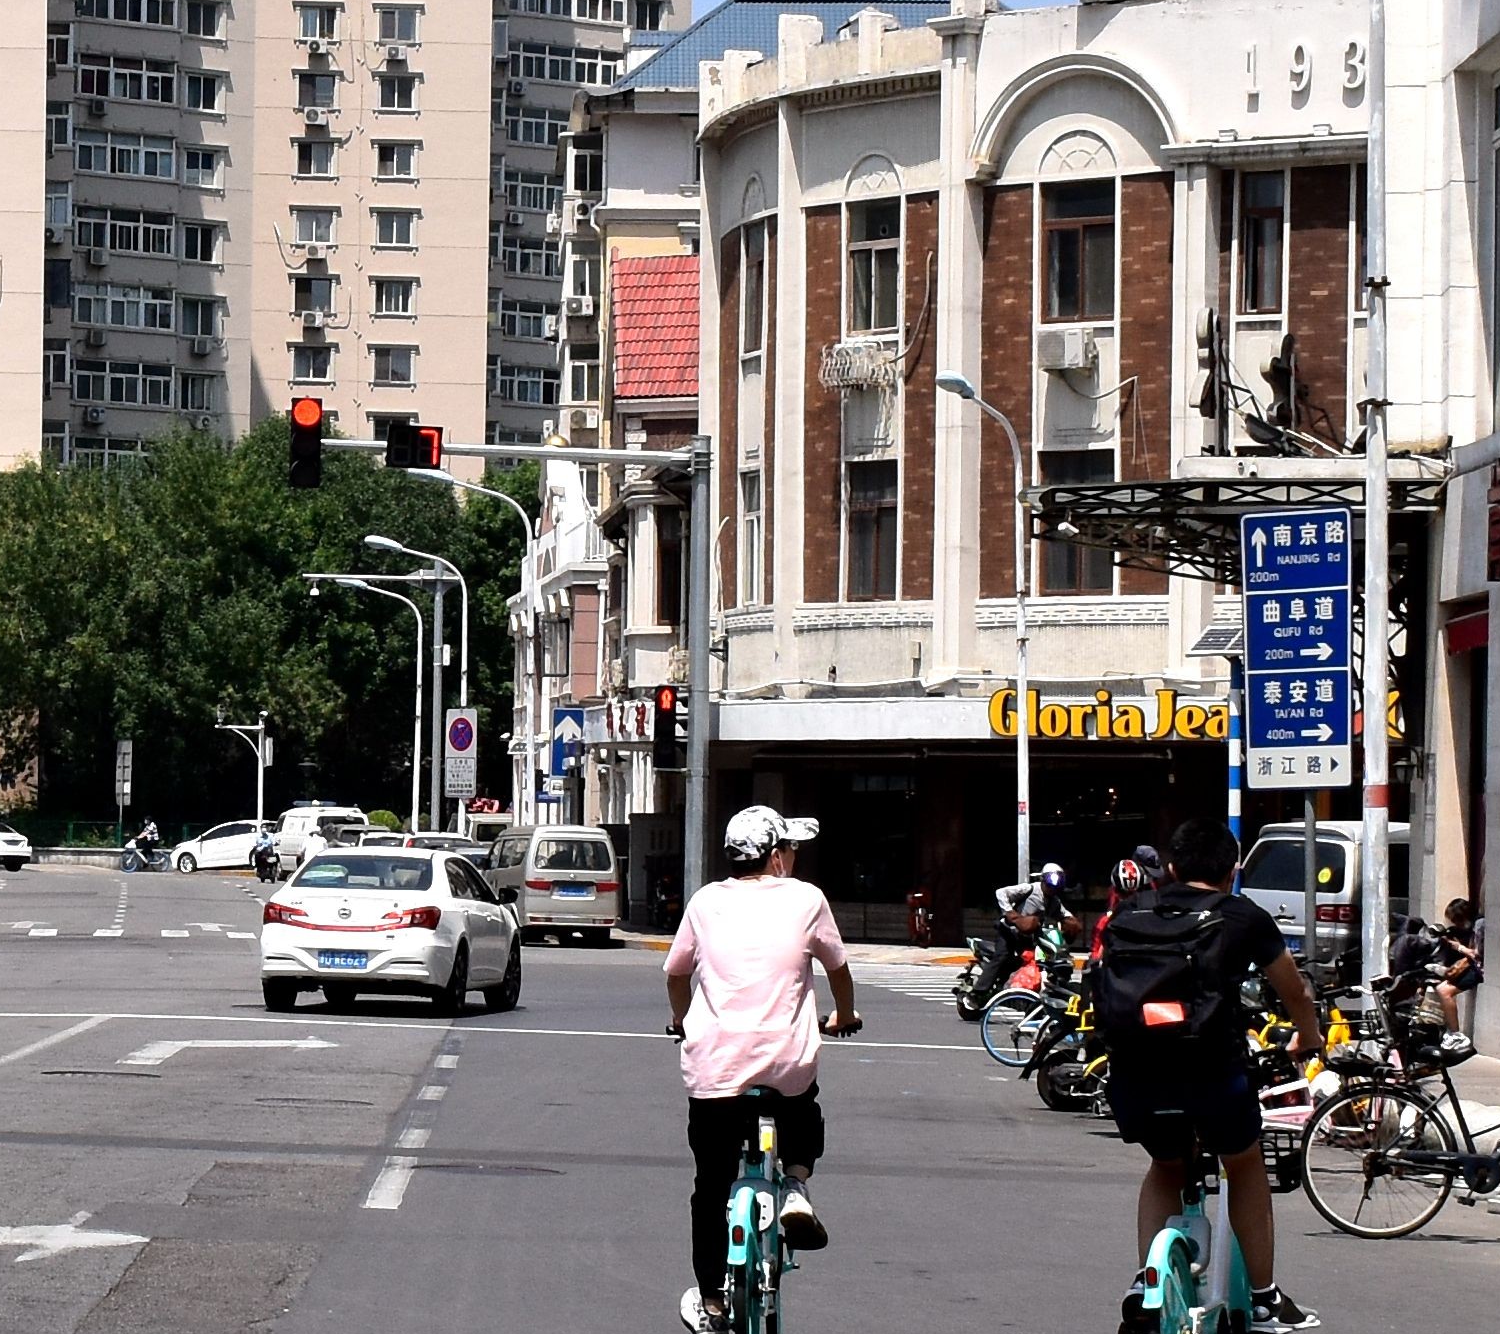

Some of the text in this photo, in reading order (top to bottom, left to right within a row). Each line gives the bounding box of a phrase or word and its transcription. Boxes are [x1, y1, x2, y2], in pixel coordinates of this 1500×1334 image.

[419, 429, 438, 465] 7
[1273, 520, 1345, 547] 南京路
[1277, 552, 1341, 565] NANJING Rd
[1249, 572, 1279, 583] 200m
[1263, 597, 1334, 623] 曲阜道
[1274, 625, 1323, 638] QUFU Rd
[1265, 649, 1294, 660] 200m
[1263, 679, 1334, 705] 泰安道
[988, 689, 1229, 738] Gloria Jea
[1310, 707, 1324, 718] Rd
[1266, 729, 1295, 740] 400m
[1257, 756, 1322, 776] 浙江路
